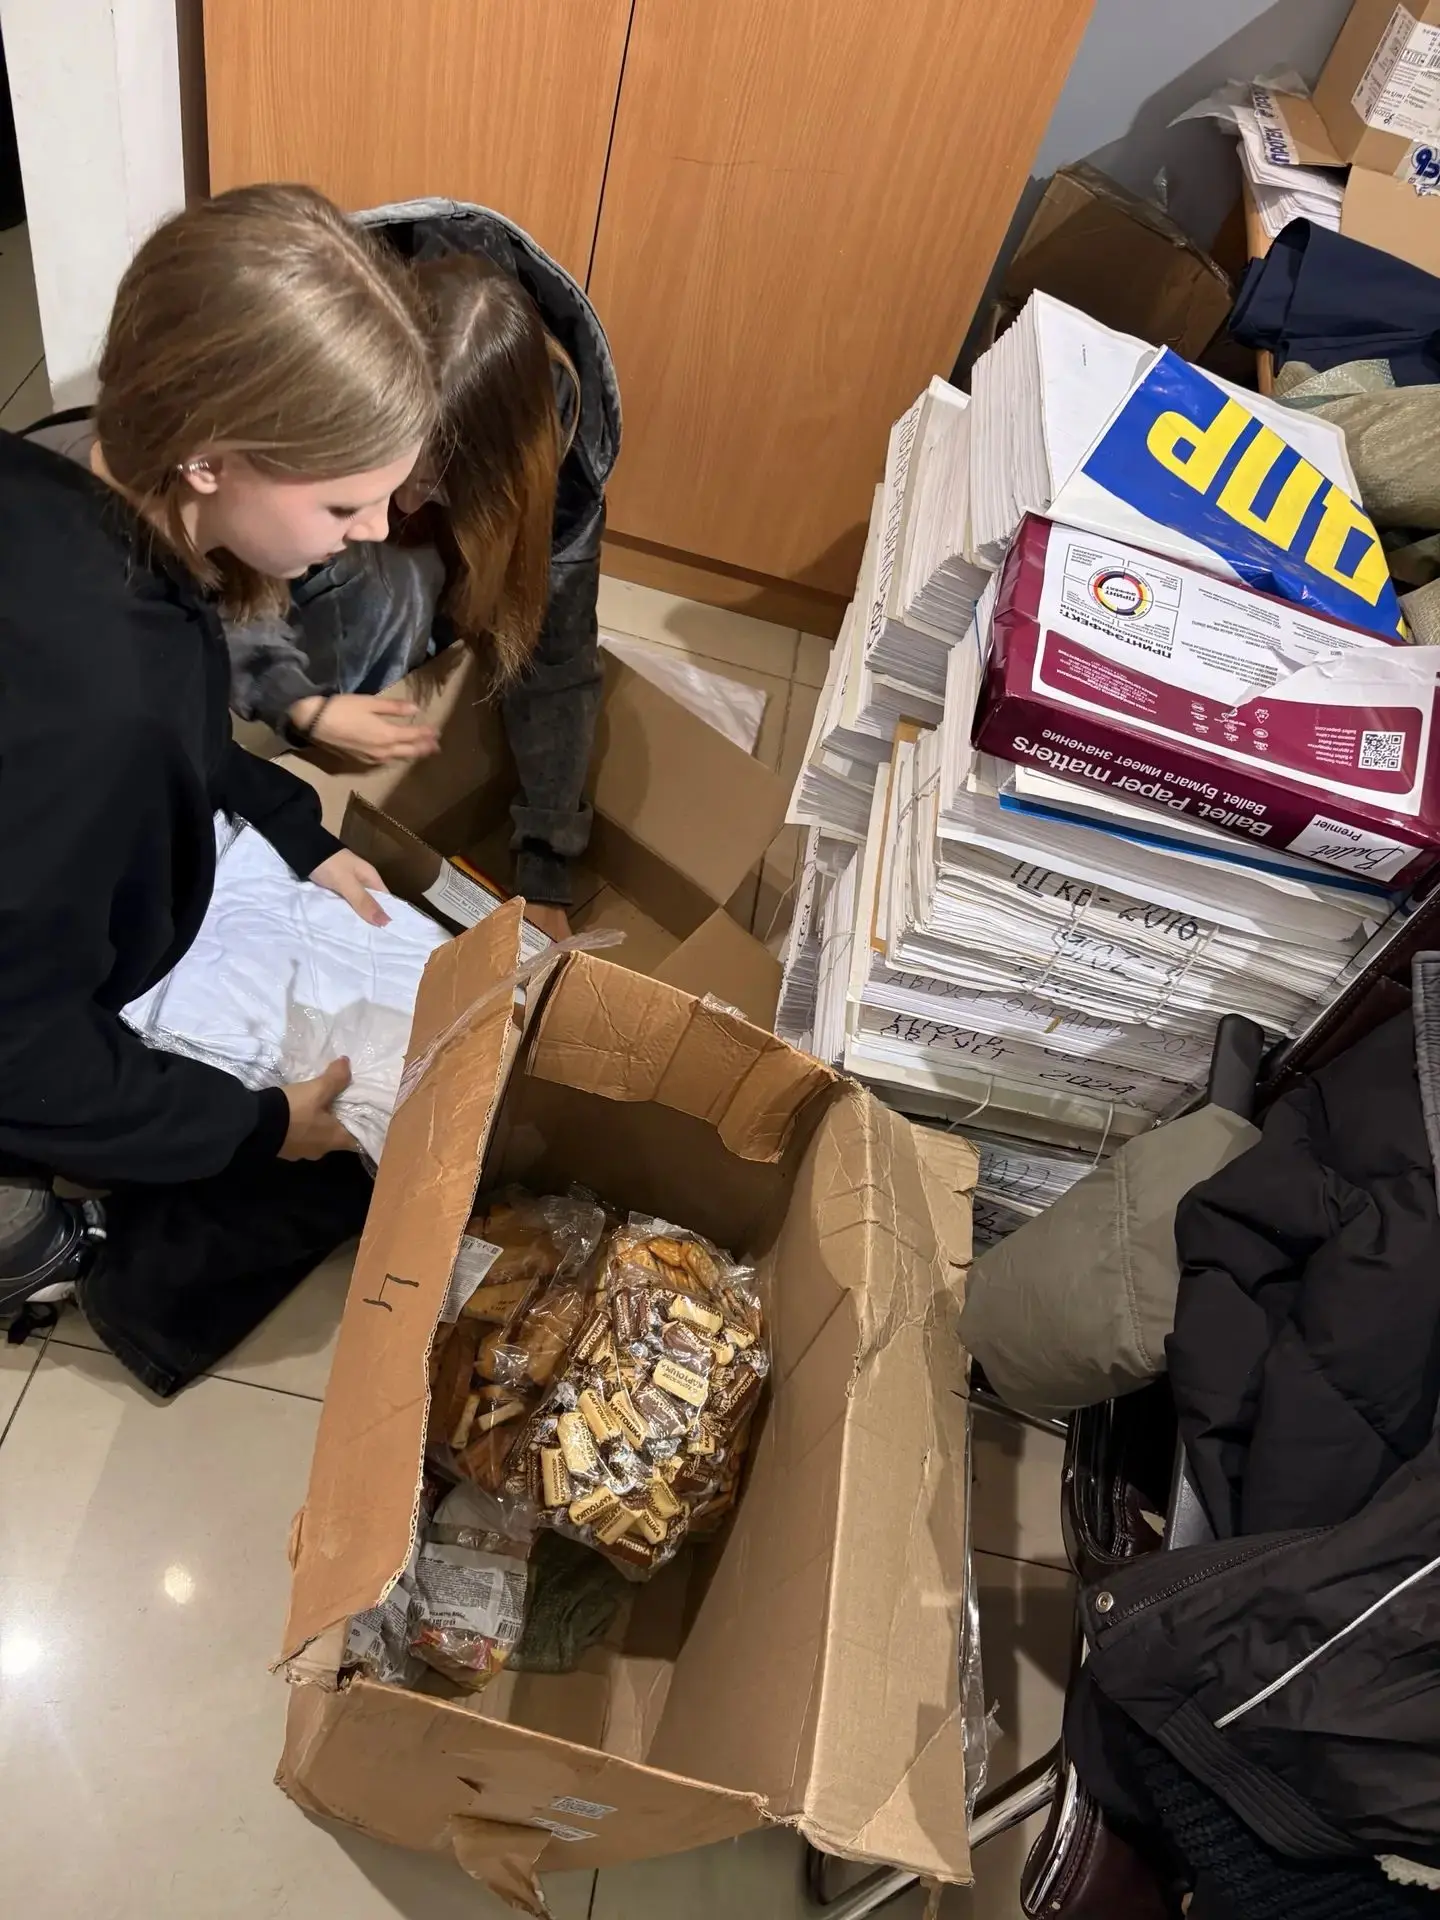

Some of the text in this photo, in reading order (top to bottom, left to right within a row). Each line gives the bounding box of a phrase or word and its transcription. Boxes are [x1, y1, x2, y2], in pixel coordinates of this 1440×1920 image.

[1146, 397, 1406, 641] ДПР
[1012, 735, 1273, 839] Ballet. Paper matters
[1041, 729, 1267, 816] Ballet. Бумага имеет значение
[1314, 818, 1361, 842] Premier
[1310, 843, 1406, 873] Ballet
[1039, 1069, 1137, 1096] 2024
[609, 1402, 641, 1440] КАРТОШКА
[574, 1494, 613, 1521] КАРТОШКА
